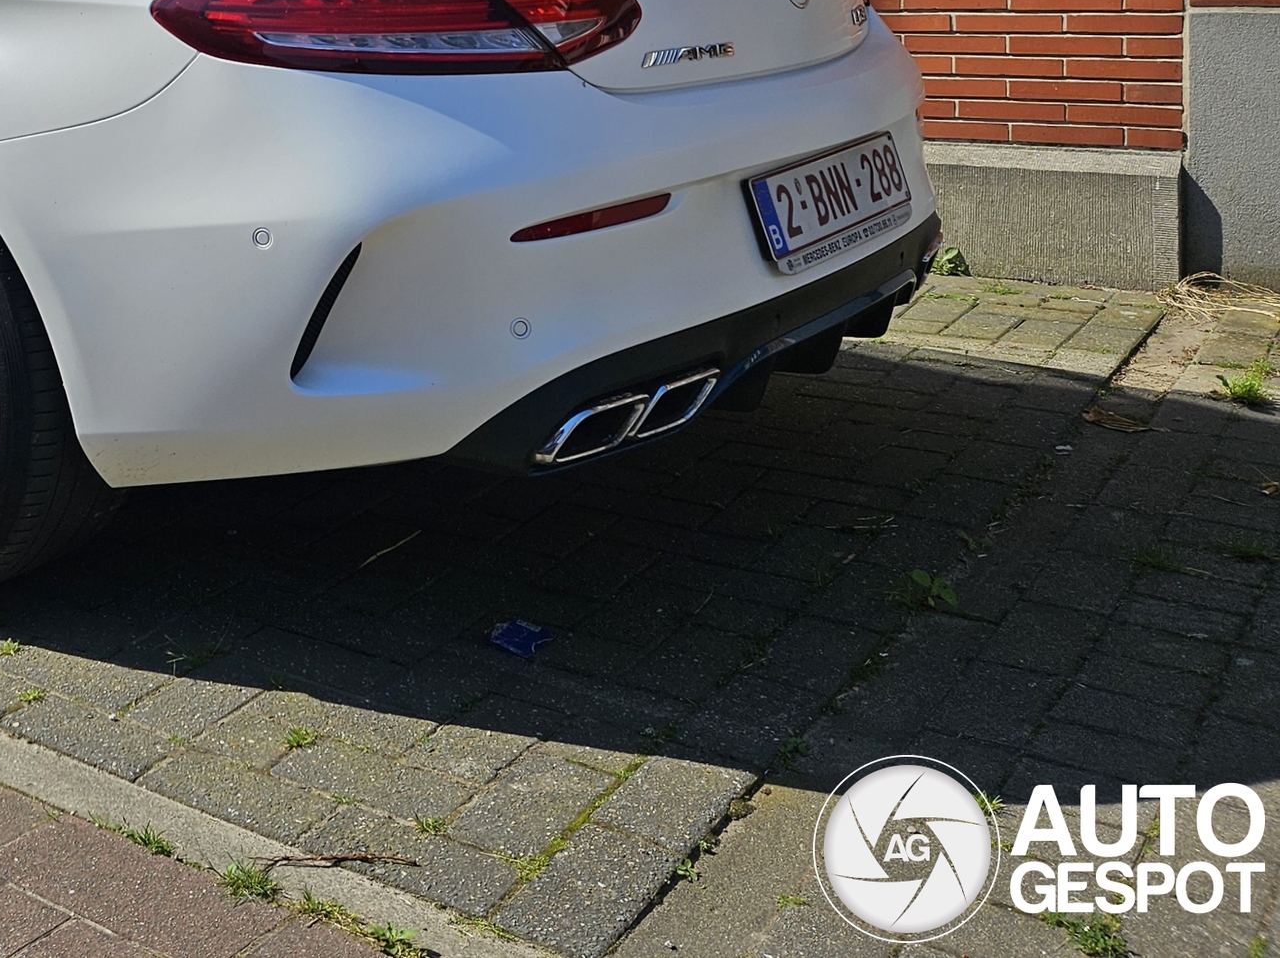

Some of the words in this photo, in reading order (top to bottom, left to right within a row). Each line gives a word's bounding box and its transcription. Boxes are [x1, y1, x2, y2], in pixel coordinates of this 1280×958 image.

[678, 41, 735, 61] AMG
[768, 224, 783, 250] B
[802, 239, 842, 266] MERCEDES-BENZ
[842, 231, 863, 249] EUROPA
